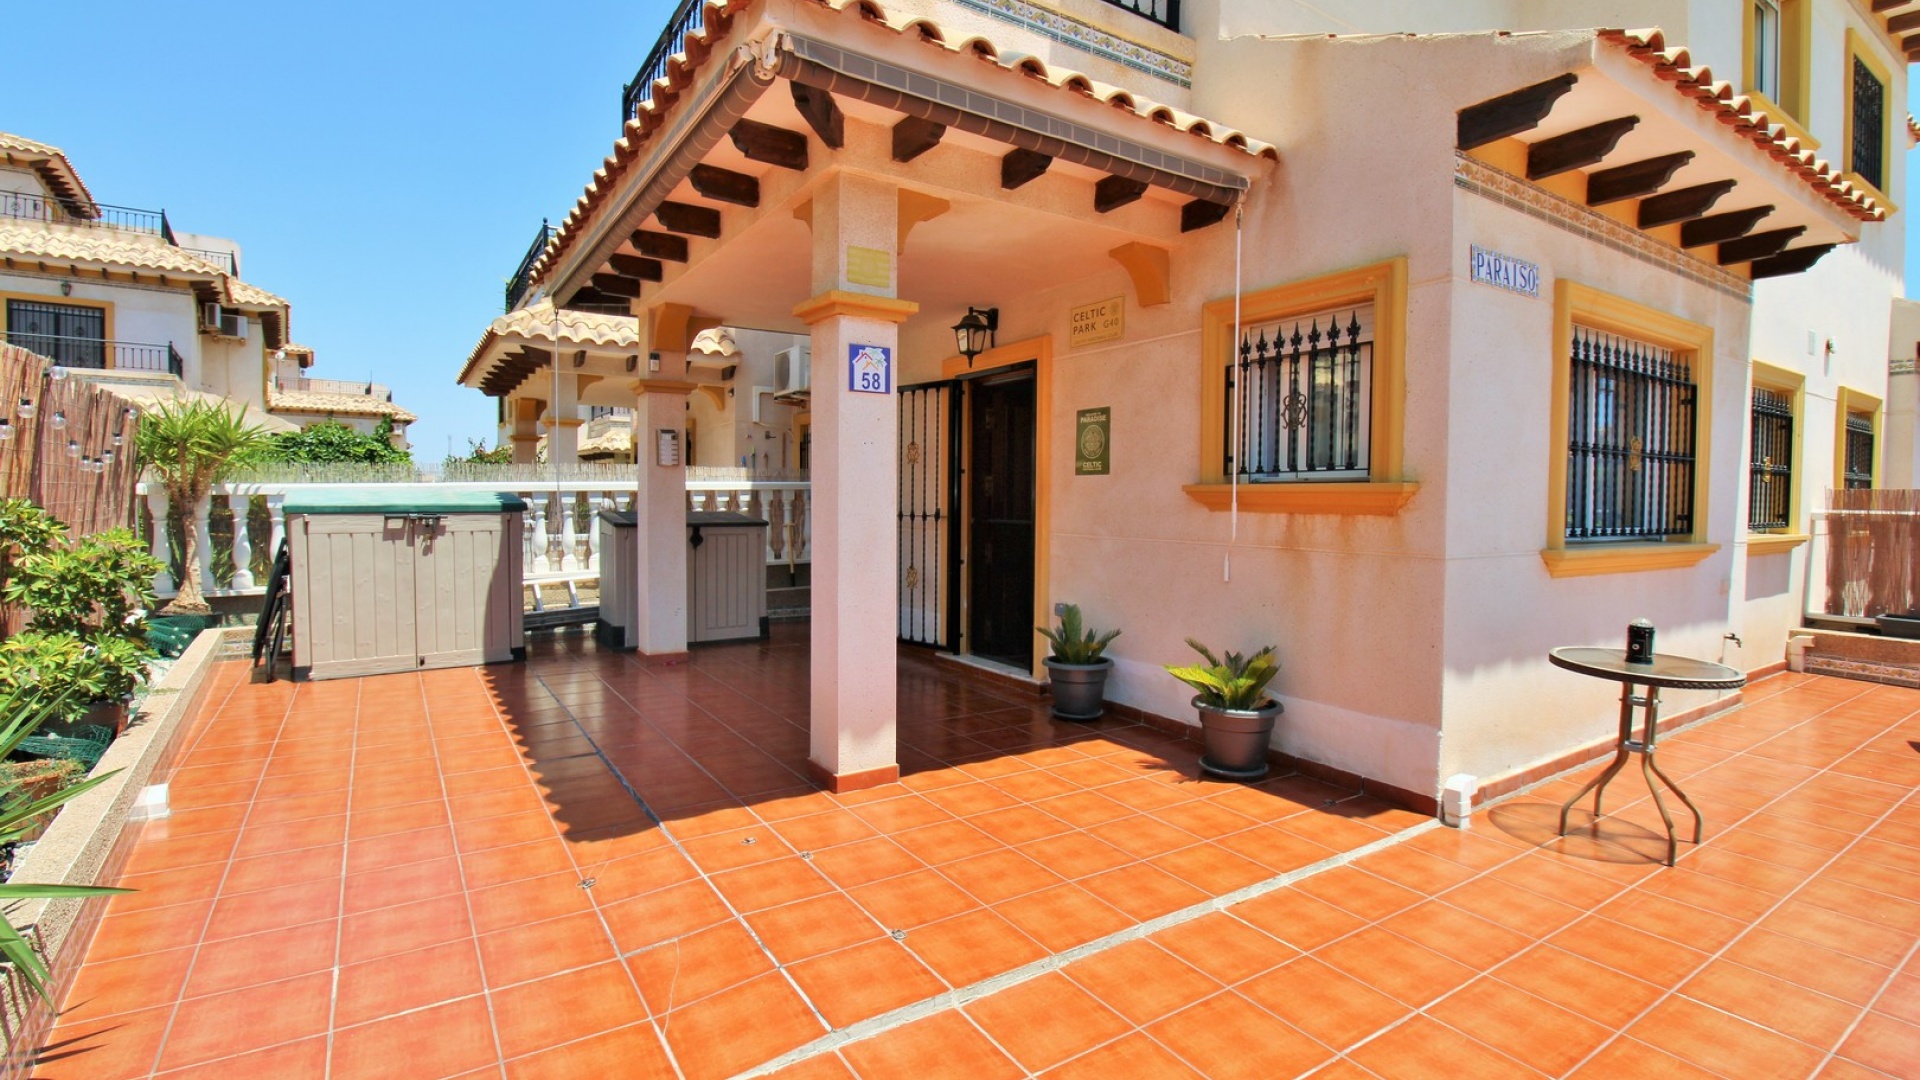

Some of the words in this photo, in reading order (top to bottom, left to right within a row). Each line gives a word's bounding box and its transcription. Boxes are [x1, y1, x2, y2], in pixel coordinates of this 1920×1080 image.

[1477, 252, 1536, 291] PARAISO
[1073, 306, 1106, 323] CELTIC
[1073, 322, 1097, 335] PARK
[862, 372, 881, 390] 58
